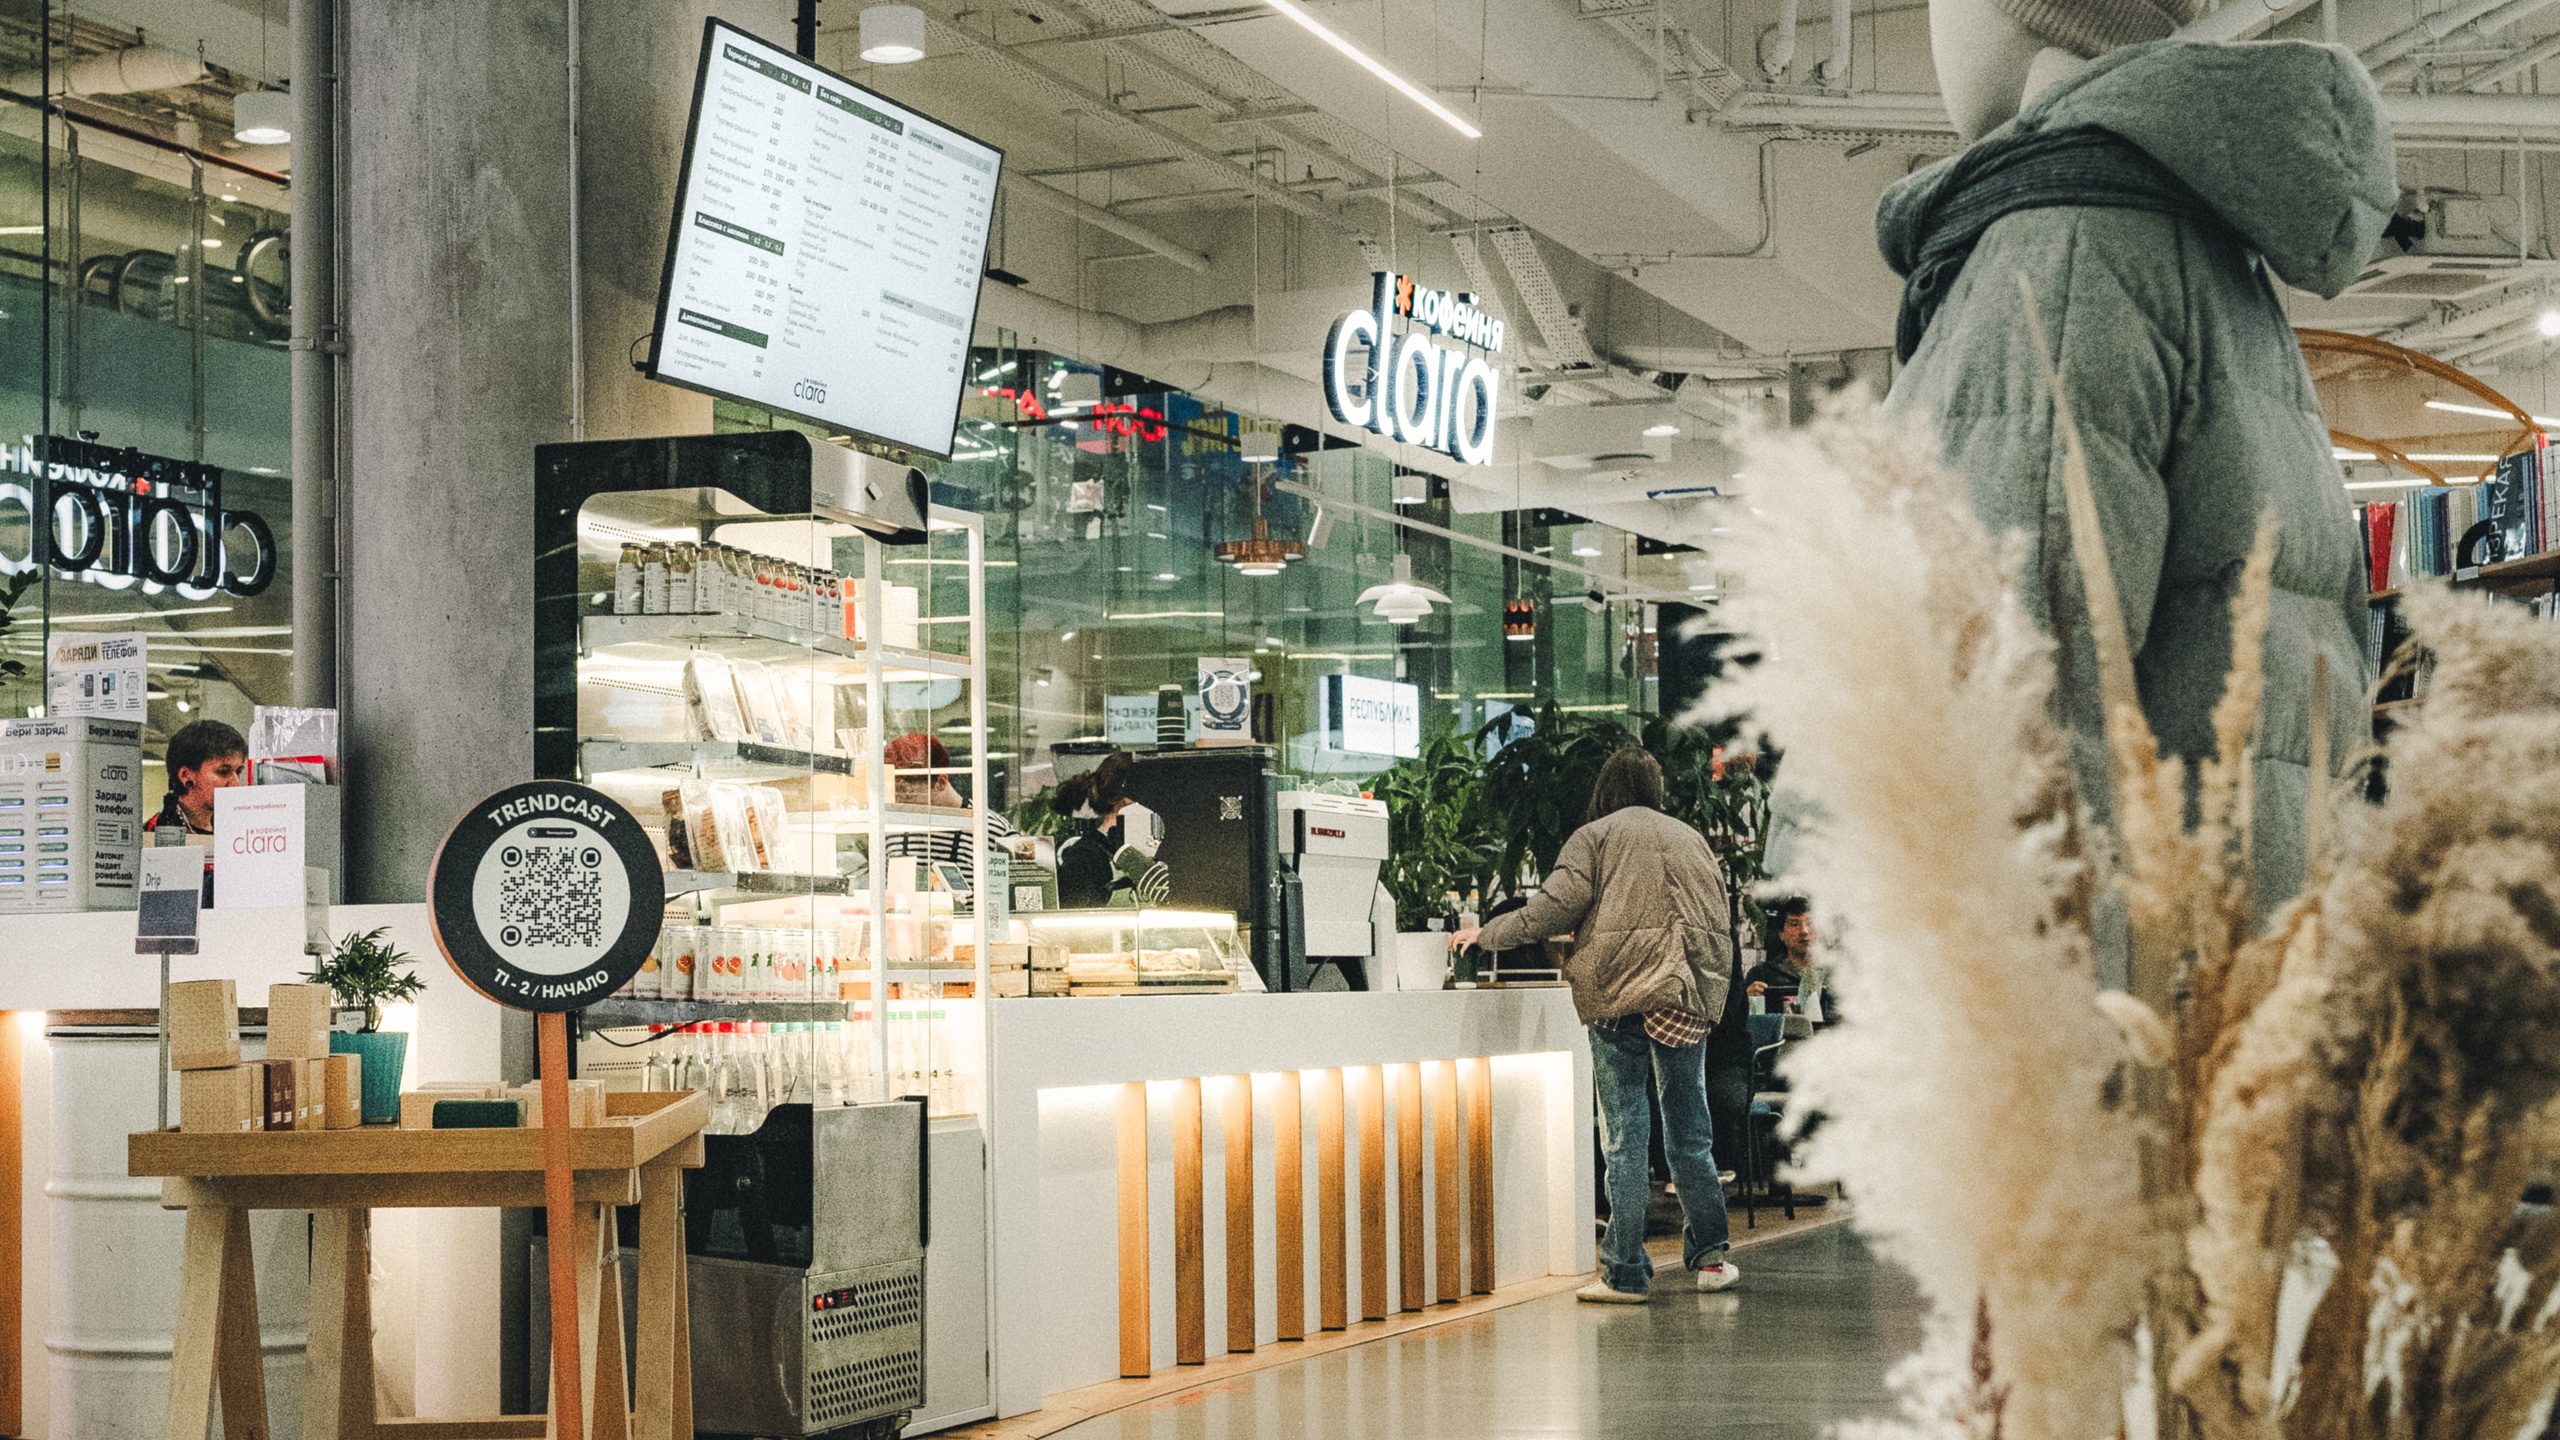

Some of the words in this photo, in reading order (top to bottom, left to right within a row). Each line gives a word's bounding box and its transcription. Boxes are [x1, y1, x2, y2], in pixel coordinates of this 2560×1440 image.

[1413, 284, 1504, 353] кофейня
[1326, 271, 1499, 466] clara
[793, 378, 827, 405] clara
[60, 646, 98, 662] ЗАРЯДИ
[101, 646, 137, 661] ТЕЛЕФОН
[1349, 697, 1412, 725] РЕСПУБЛИКА
[5, 727, 31, 738] Бери
[34, 725, 68, 737] заряд!
[88, 725, 111, 737] Бери
[112, 728, 139, 739] заряд!
[100, 764, 128, 781] clara
[95, 790, 127, 802] Заряди
[95, 804, 133, 816] телефон
[488, 793, 616, 828] TRENDCAST
[255, 825, 287, 834] кофейня
[232, 829, 287, 854] clara
[95, 851, 124, 861] Автомат
[95, 862, 121, 871] выдает
[95, 871, 133, 881] powerbank
[145, 873, 162, 889] Drip
[520, 979, 530, 995] 2
[542, 969, 610, 998] НАЧАЛО
